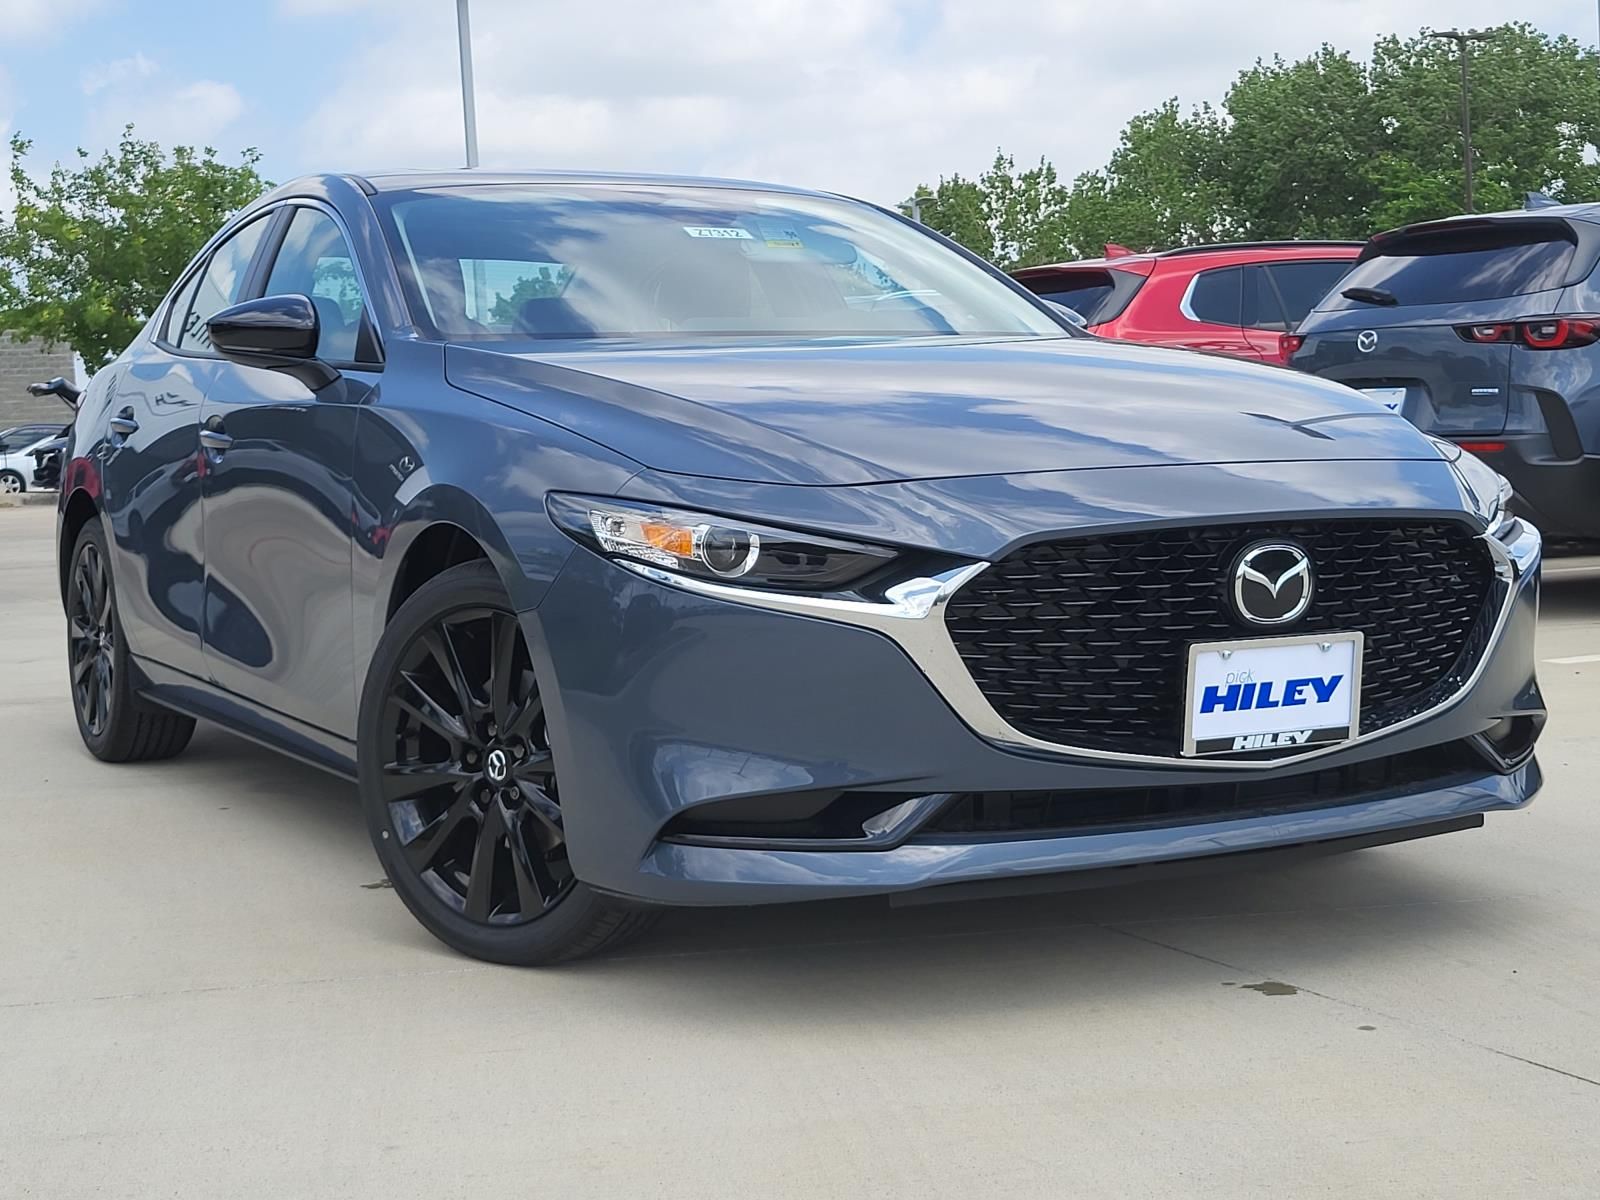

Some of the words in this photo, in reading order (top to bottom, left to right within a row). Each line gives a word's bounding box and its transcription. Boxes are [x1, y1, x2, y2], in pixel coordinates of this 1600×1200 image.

[1225, 669, 1255, 686] pick
[1200, 675, 1343, 713] HILEY
[1233, 731, 1312, 750] HILEY
